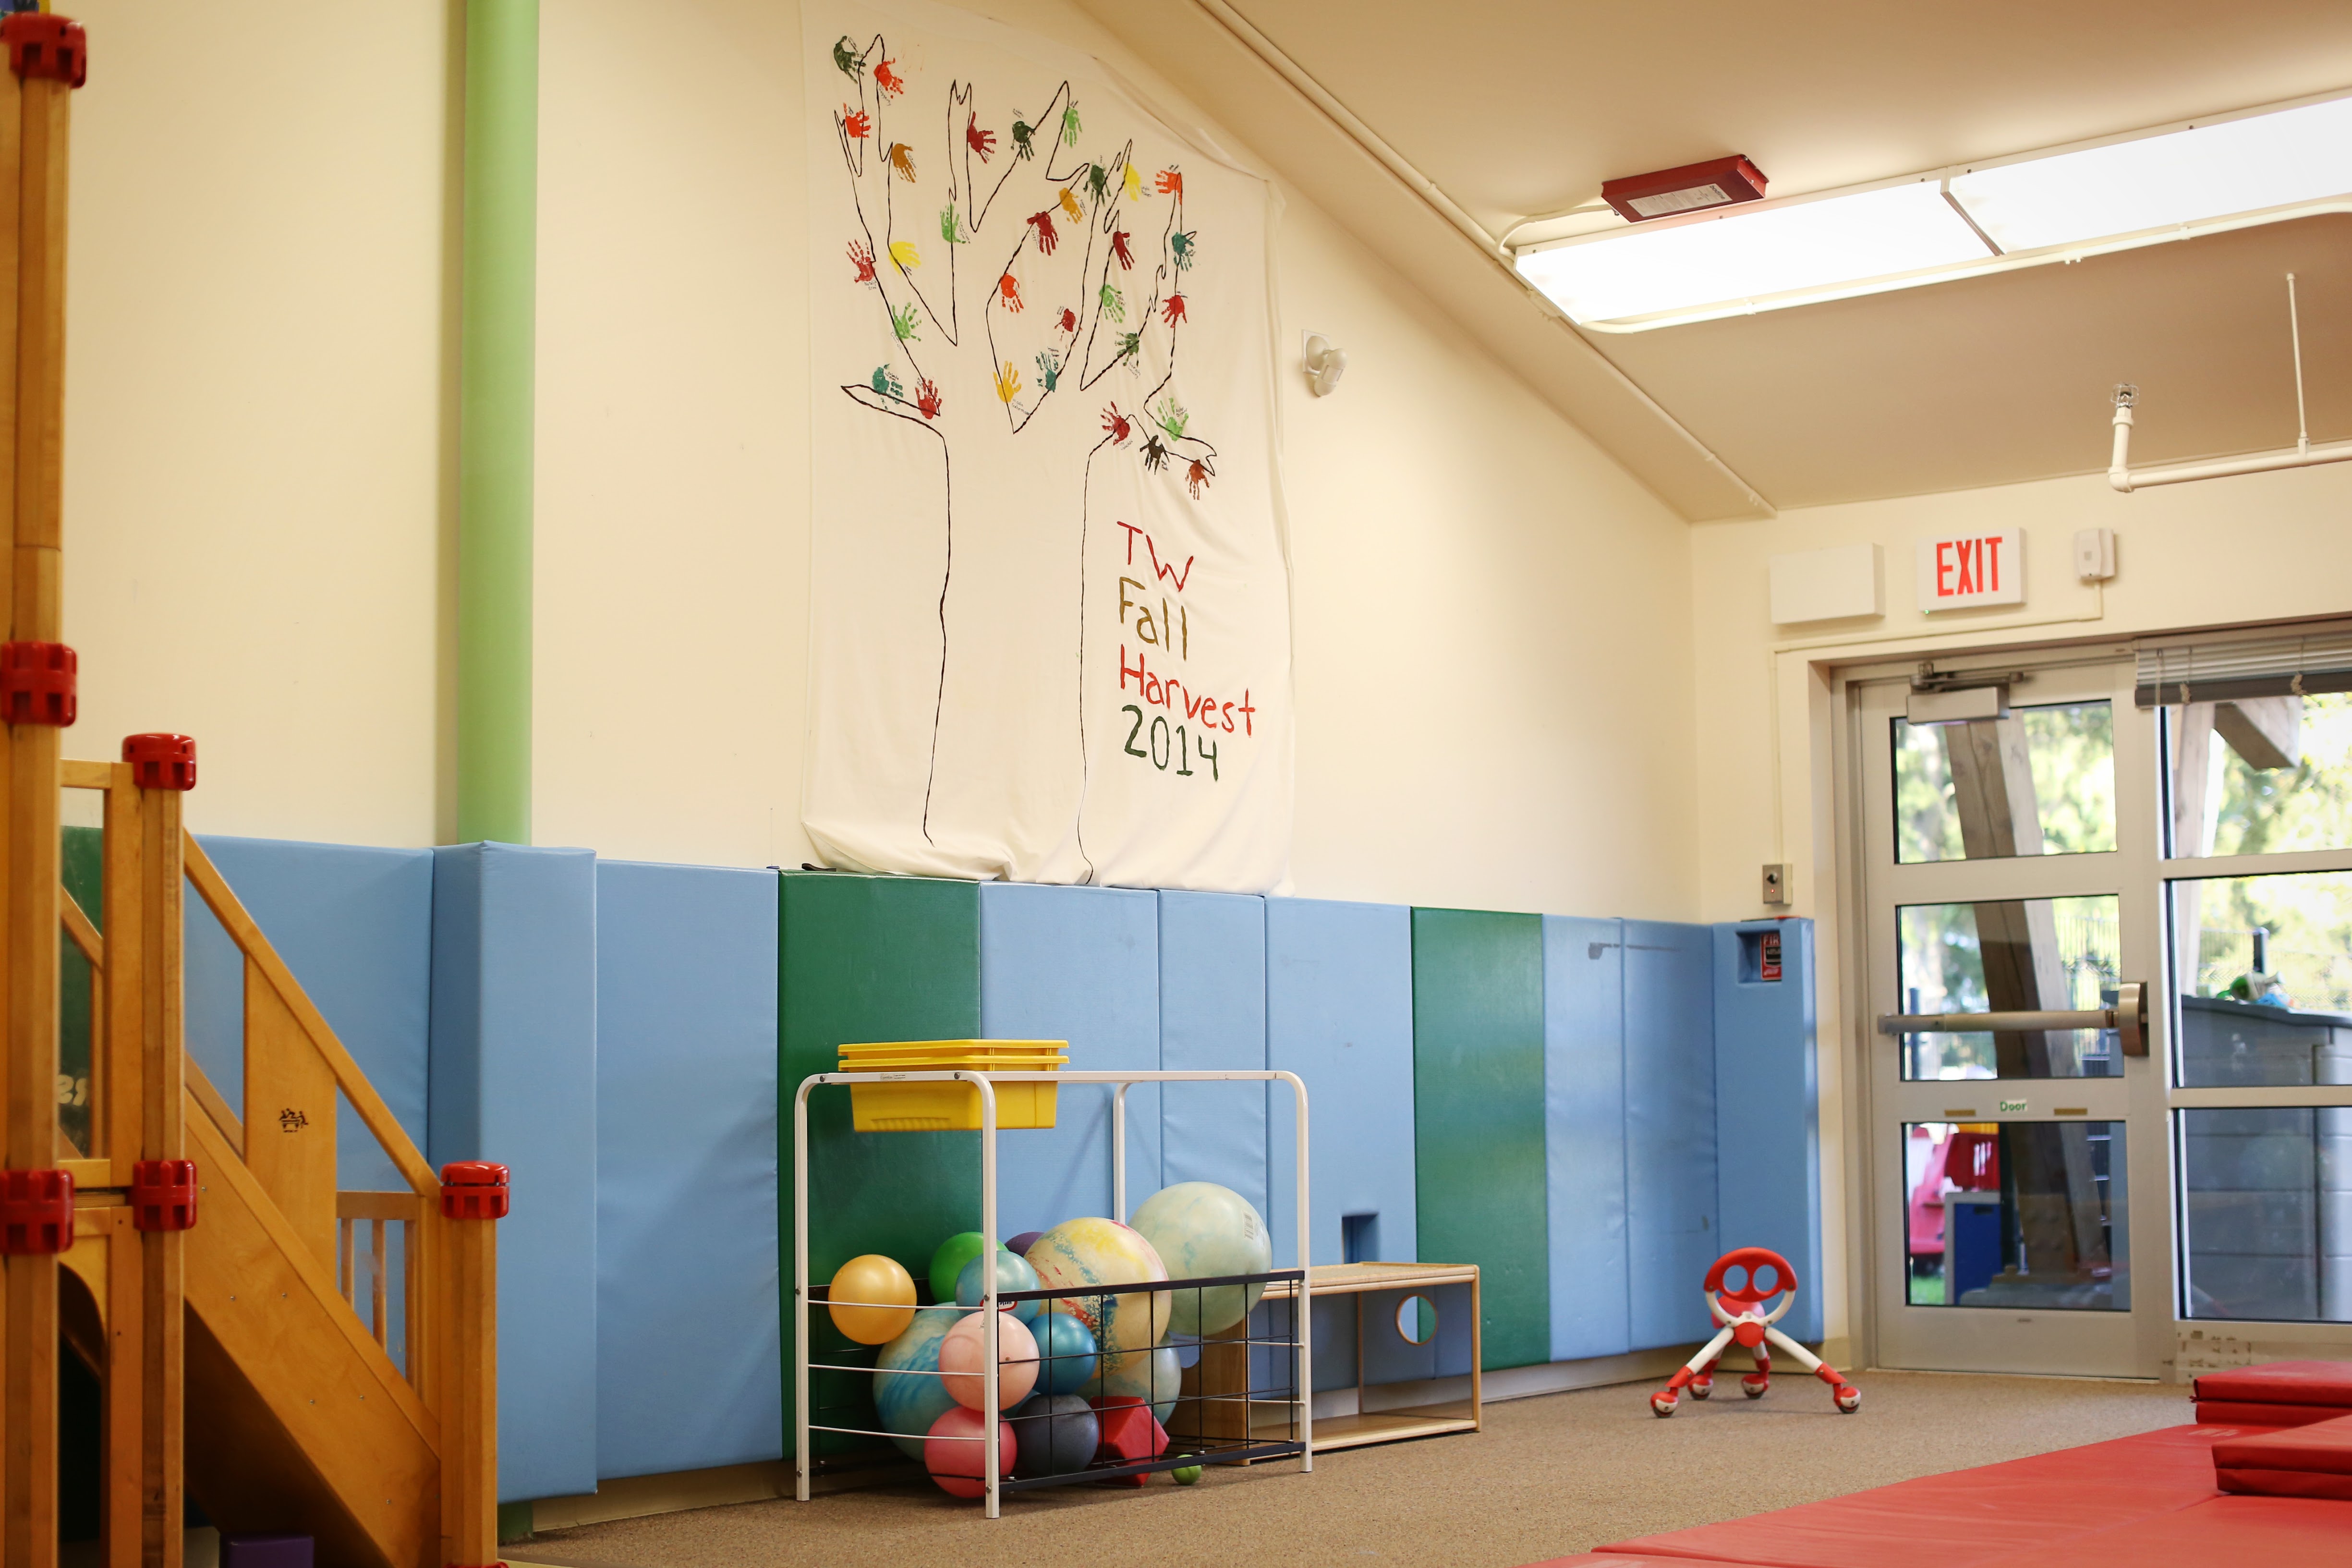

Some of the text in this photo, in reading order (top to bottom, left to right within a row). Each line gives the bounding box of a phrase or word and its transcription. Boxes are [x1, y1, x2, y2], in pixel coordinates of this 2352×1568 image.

[1117, 521, 1194, 592] TW
[1937, 536, 2003, 597] EXIT
[1119, 576, 1188, 661] Fall
[1120, 644, 1256, 738] Harvest
[1122, 705, 1219, 782] 2014
[1763, 934, 1780, 946] FIR
[2000, 1101, 2027, 1112] Door
